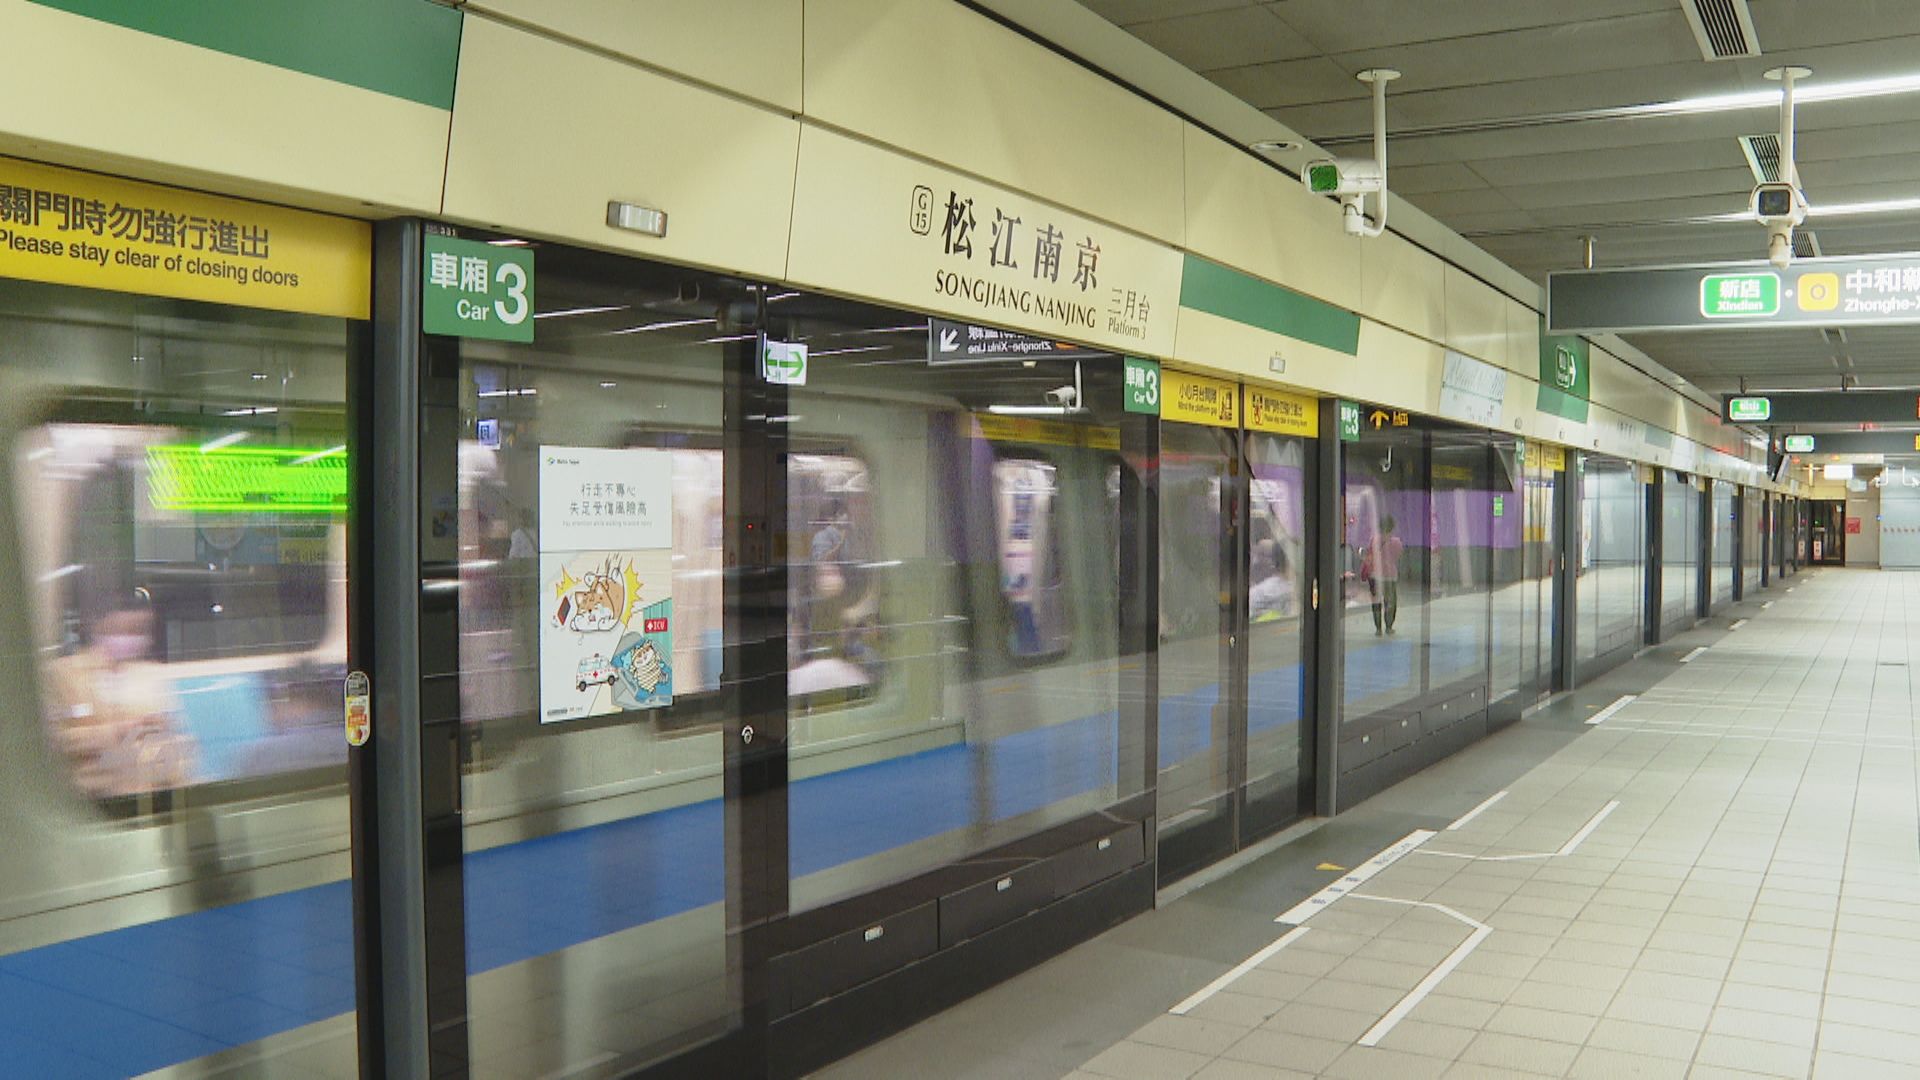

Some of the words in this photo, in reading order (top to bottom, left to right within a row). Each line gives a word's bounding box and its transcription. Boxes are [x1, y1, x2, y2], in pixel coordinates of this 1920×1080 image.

[918, 193, 928, 210] G
[915, 212, 927, 228] 15
[941, 190, 1101, 292] 松江南京
[69, 241, 110, 267] stay
[115, 247, 159, 268] clear
[164, 254, 182, 271] of
[186, 255, 248, 284] closing
[252, 265, 299, 287] doors
[429, 252, 488, 294] 車廂
[494, 262, 528, 325] 3
[935, 269, 1031, 313] SONGJIANG
[1034, 294, 1096, 328] NANJING
[1719, 279, 1760, 298] 新店
[457, 299, 489, 322] Car
[1107, 287, 1150, 323] 三月台
[1717, 300, 1763, 312] Xindian
[1108, 316, 1139, 338] Platform
[1141, 325, 1147, 340] 3
[1145, 369, 1158, 406] 3
[1352, 409, 1359, 436] 3
